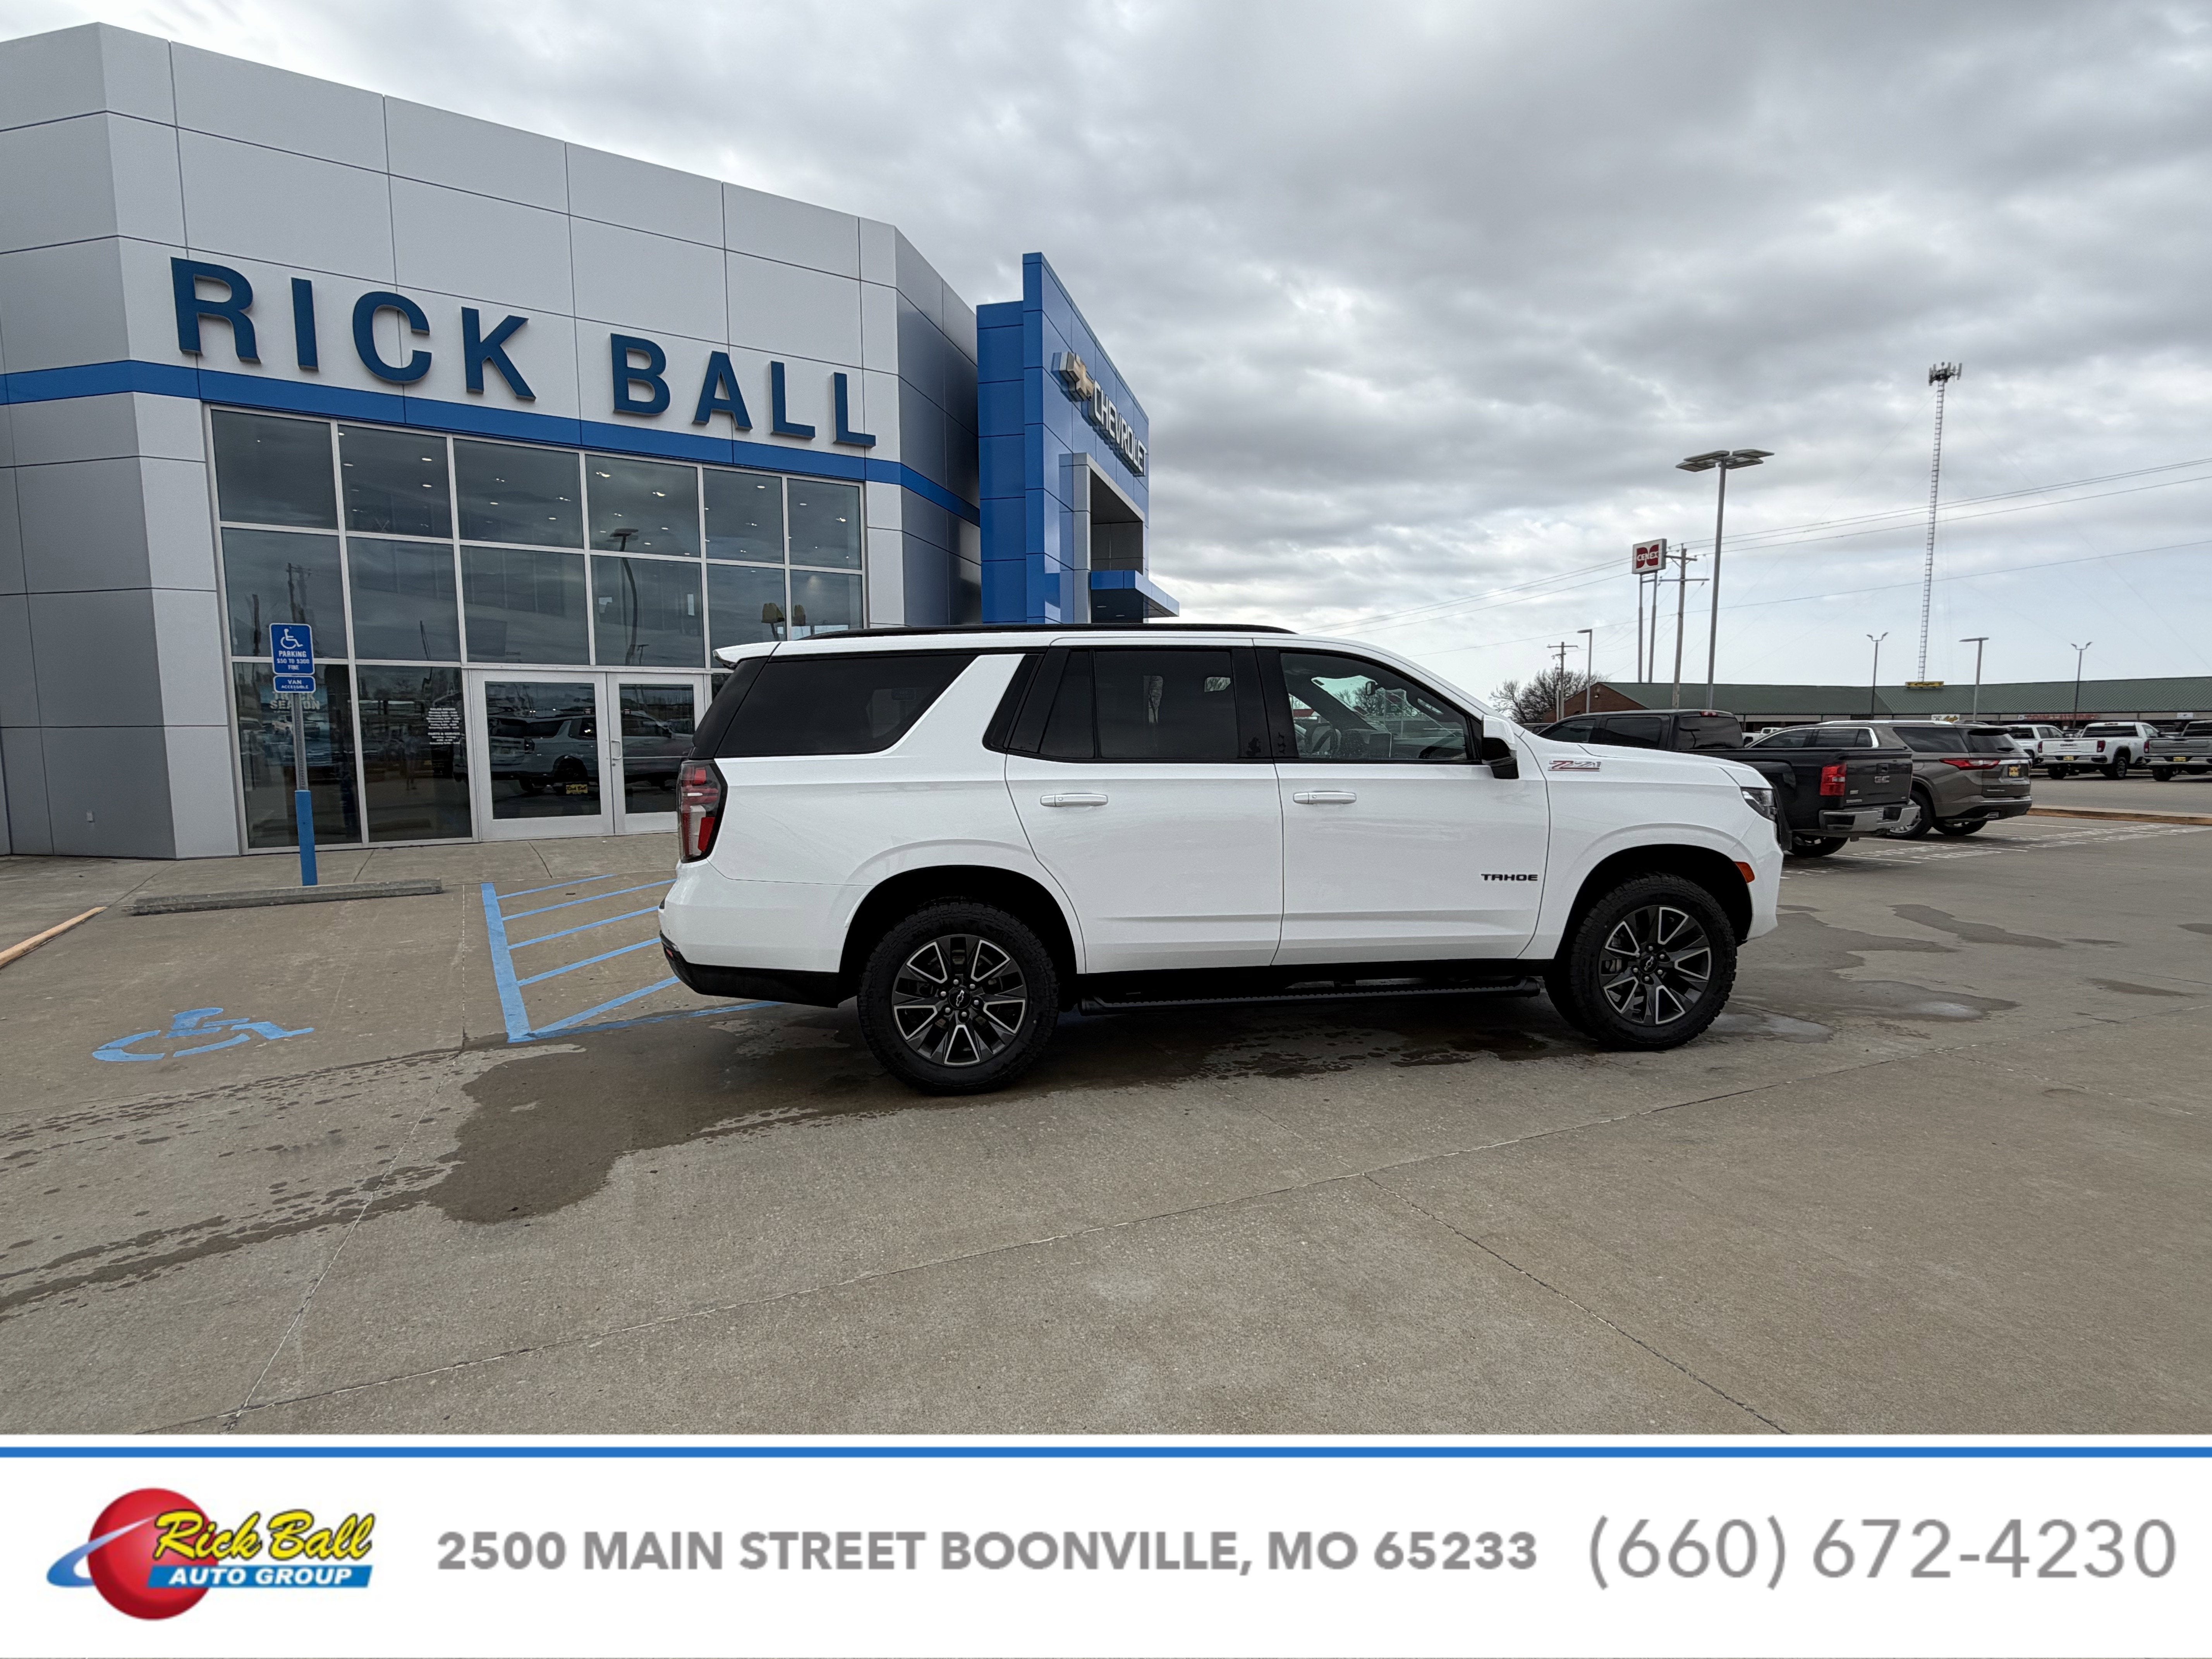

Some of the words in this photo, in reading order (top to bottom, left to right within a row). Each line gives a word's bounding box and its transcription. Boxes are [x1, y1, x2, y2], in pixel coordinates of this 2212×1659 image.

[170, 257, 536, 401] RICK
[610, 332, 877, 447] BALL
[1094, 380, 1147, 476] CHEVROLET
[270, 700, 320, 710] SEAON
[1548, 761, 1602, 772] Z71
